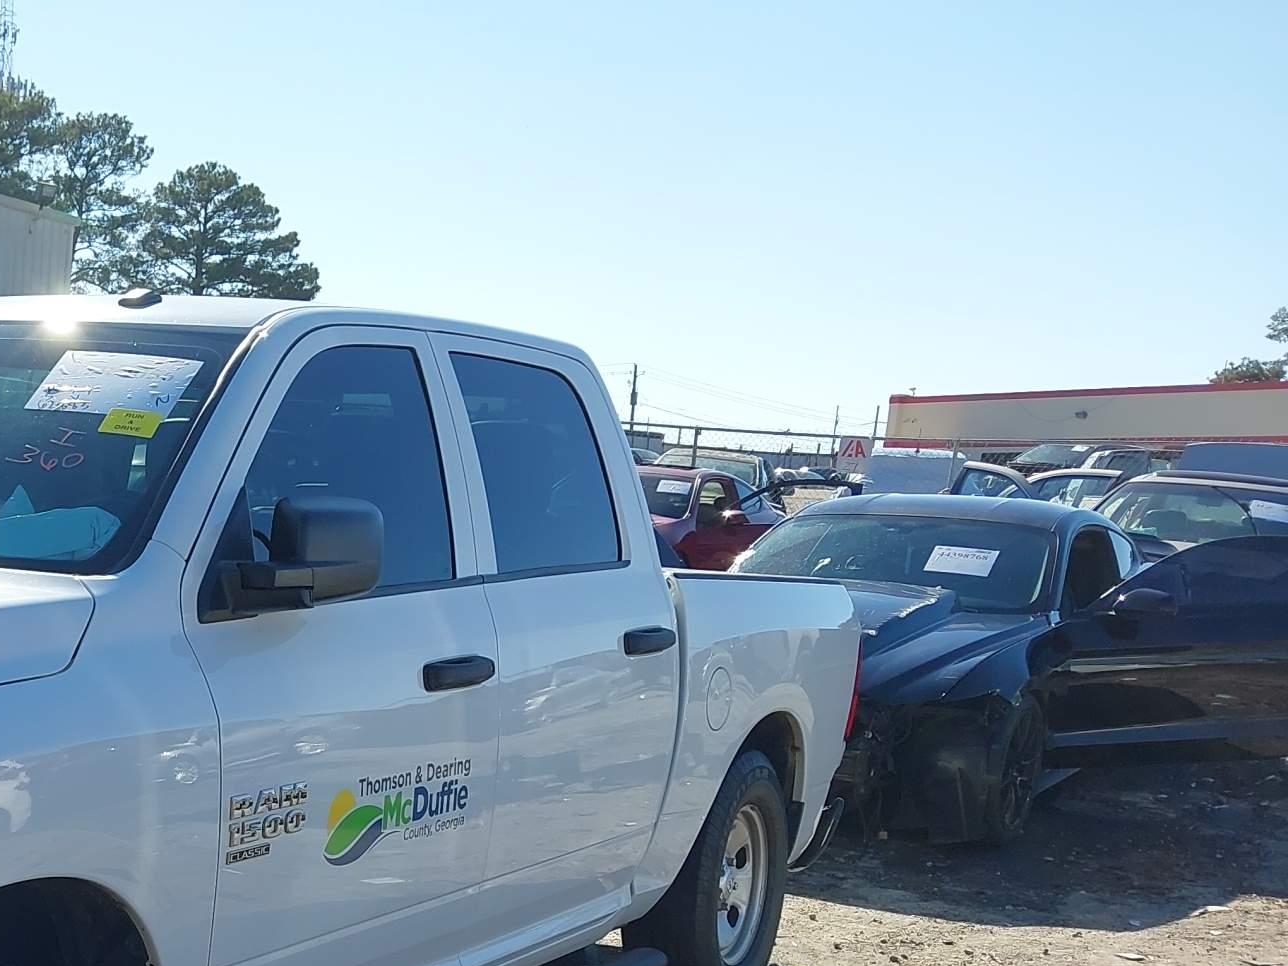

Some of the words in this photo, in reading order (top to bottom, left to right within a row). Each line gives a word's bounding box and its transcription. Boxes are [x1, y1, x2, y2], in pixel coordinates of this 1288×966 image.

[114, 424, 142, 433] DRIVE
[124, 412, 145, 420] RUN
[5, 443, 84, 471] 360
[359, 772, 412, 797] Thomson
[414, 765, 423, 784] &
[426, 757, 471, 783] Dearing
[229, 781, 308, 821] RAM
[382, 779, 469, 831] McDuffie
[228, 808, 306, 848] 1500
[403, 823, 433, 841] County,
[435, 814, 465, 834] Georgia
[230, 845, 270, 863] CLASSIC
